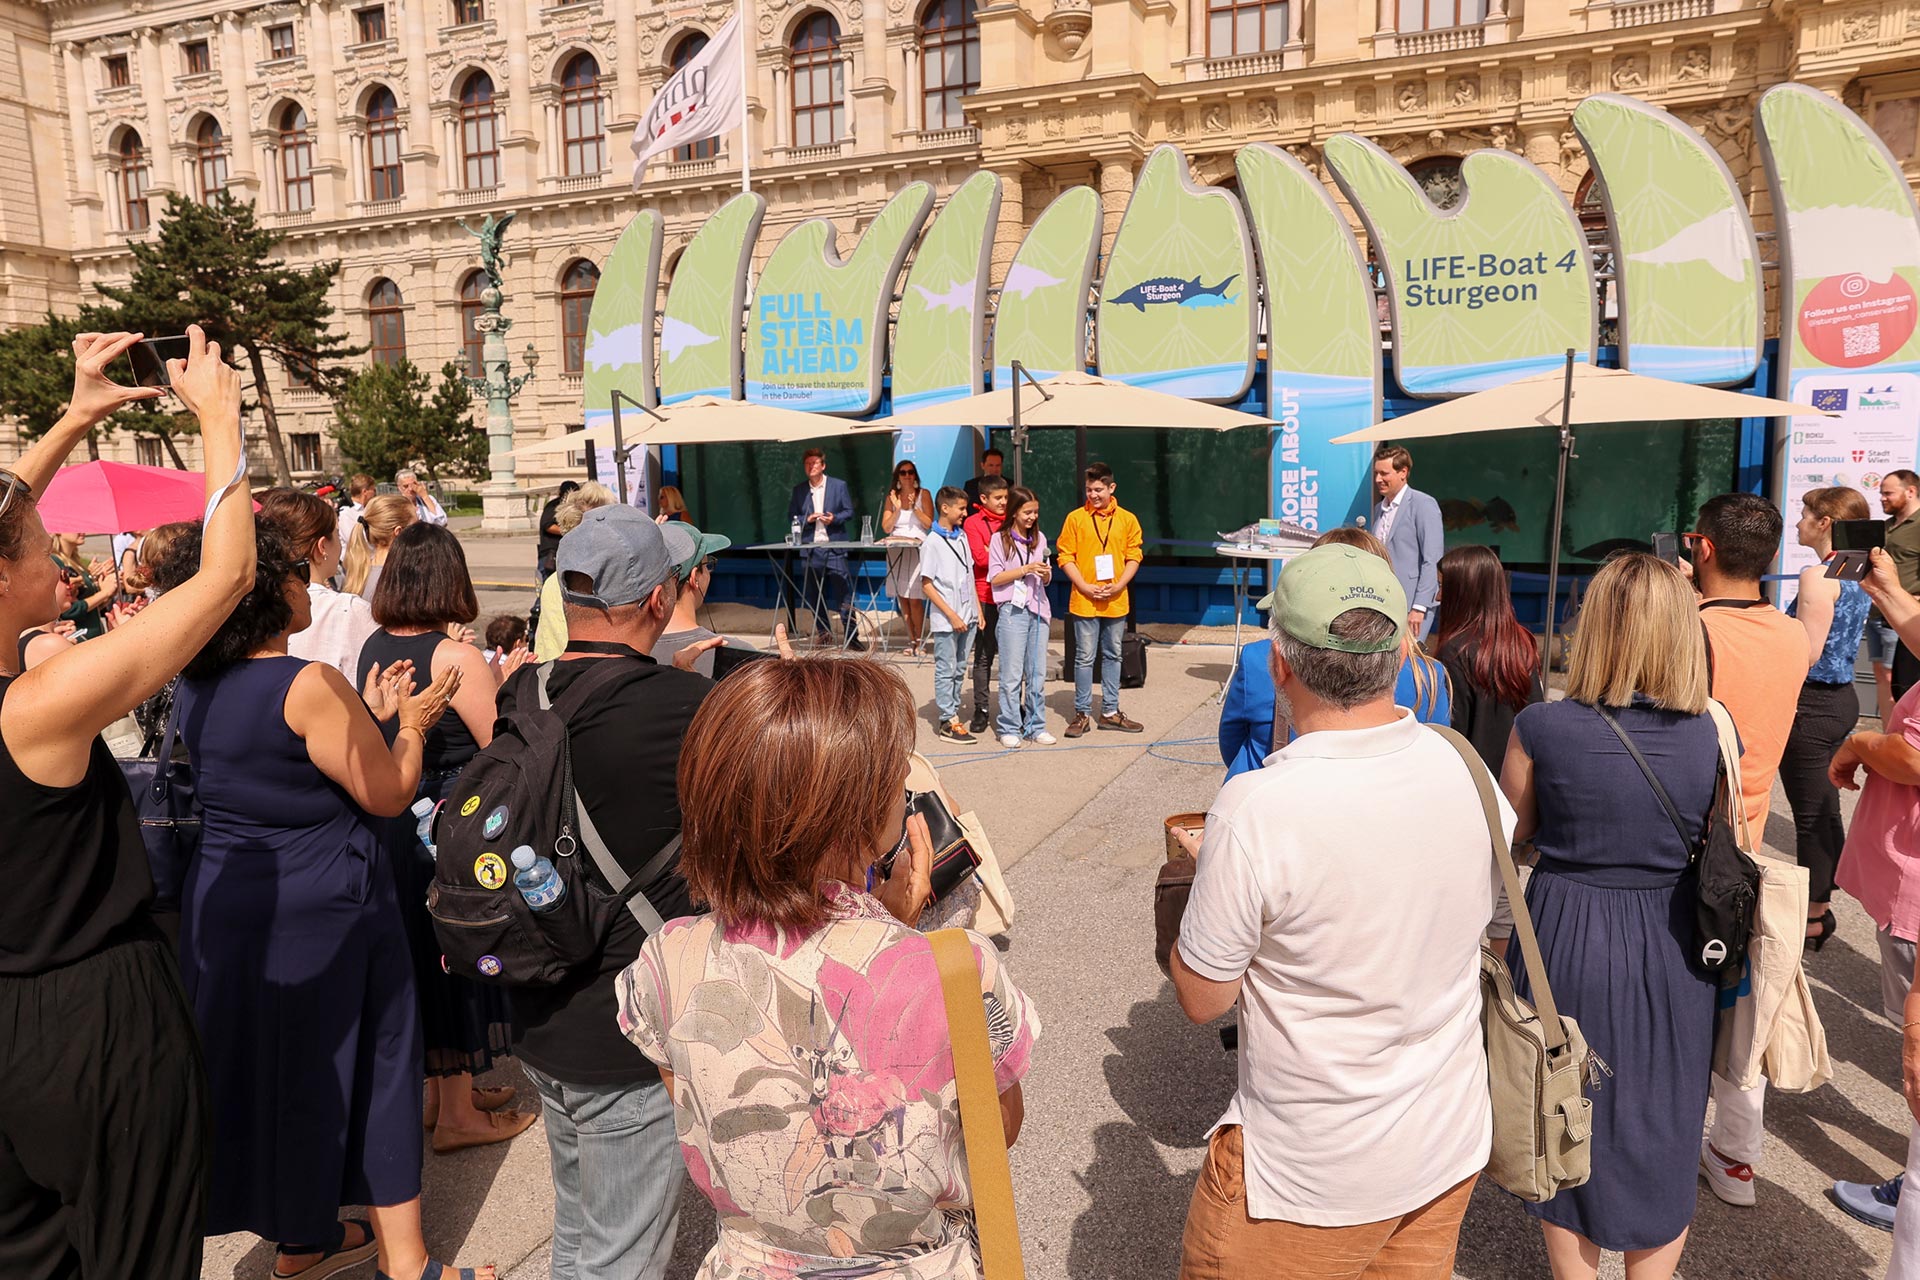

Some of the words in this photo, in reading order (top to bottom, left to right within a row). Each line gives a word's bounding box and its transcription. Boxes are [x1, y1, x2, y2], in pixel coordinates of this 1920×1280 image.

[1406, 251, 1547, 282] LIFE-Boat
[1555, 249, 1577, 273] 4
[1140, 284, 1177, 294] LIFE-Boat
[1178, 283, 1185, 291] 4
[1146, 291, 1181, 301] Sturgeon
[1405, 283, 1537, 309] Sturgeon
[760, 292, 831, 321] FULL
[1804, 308, 1835, 319] Follow
[1836, 305, 1848, 313] us
[1848, 303, 1861, 311] on
[1862, 295, 1911, 308] Instagram
[760, 318, 864, 348] STEAM
[762, 346, 859, 375] AHEAD
[762, 382, 777, 390] Join
[827, 381, 864, 390] sturgeons
[770, 391, 781, 399] the
[1281, 387, 1300, 464] ABOUT
[902, 430, 916, 464] .EU
[1793, 455, 1844, 464] viadonau
[1300, 466, 1319, 531] OJECT
[1340, 593, 1361, 602] RALPH
[1349, 586, 1375, 594] POLO
